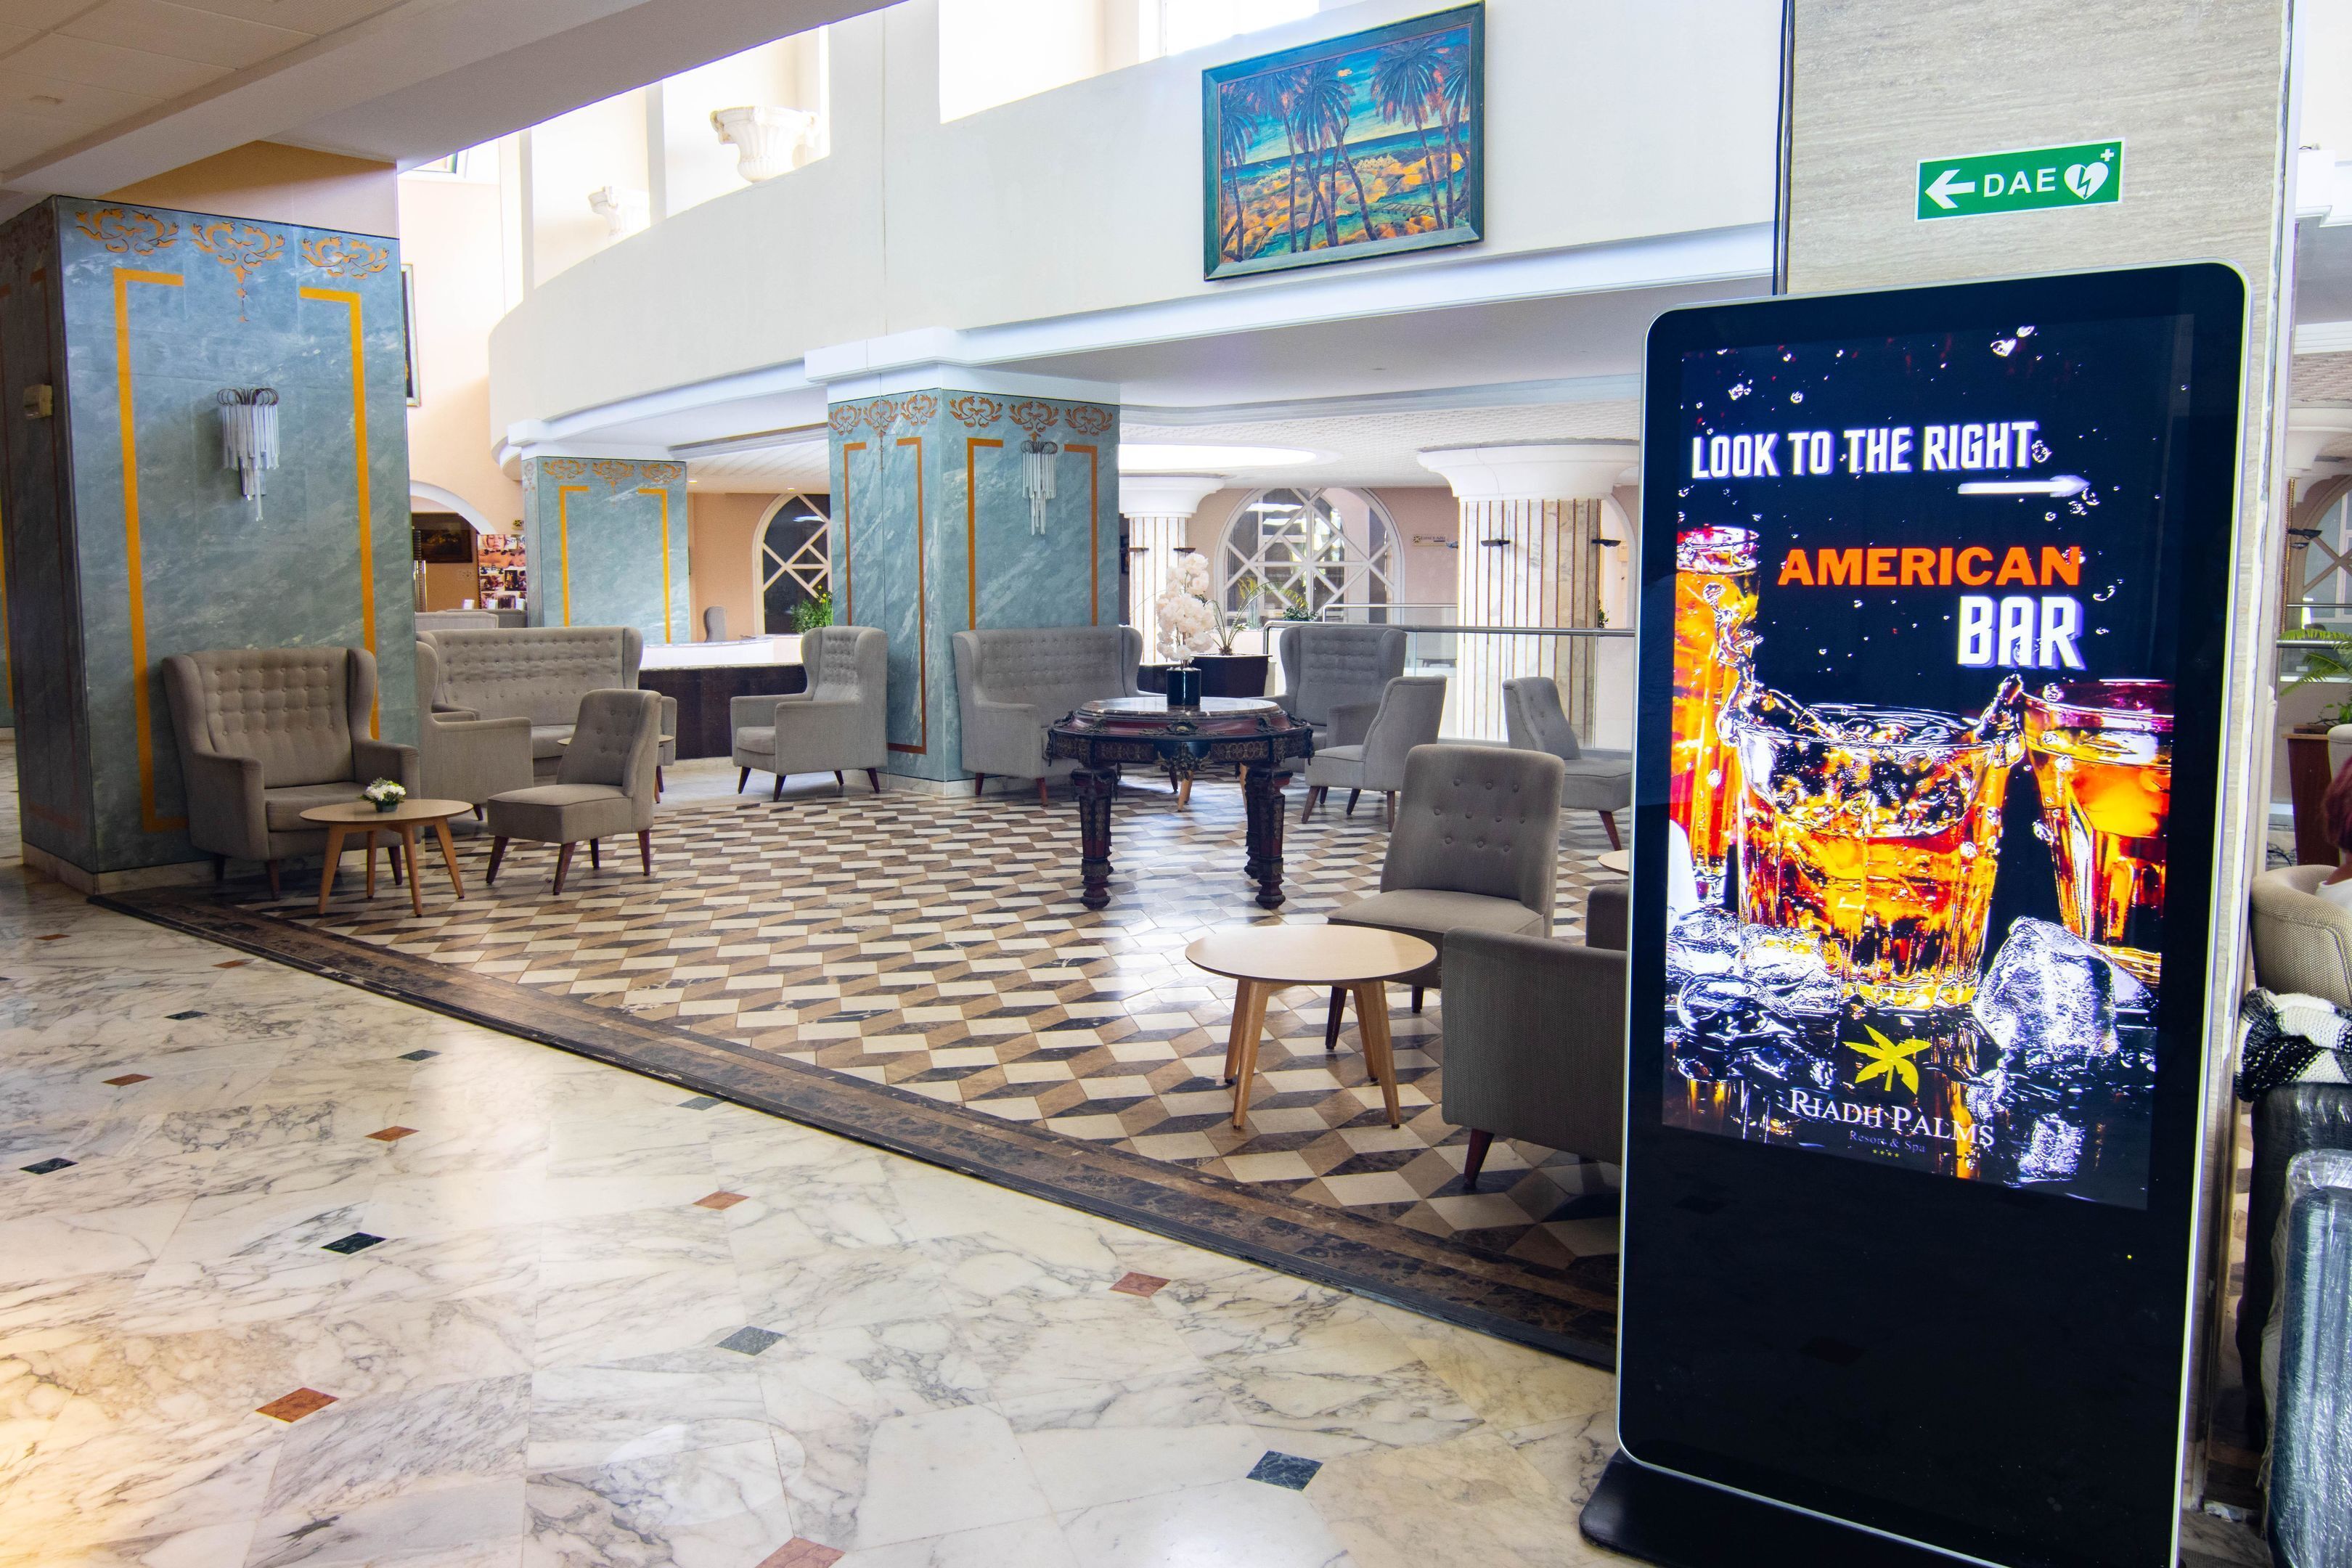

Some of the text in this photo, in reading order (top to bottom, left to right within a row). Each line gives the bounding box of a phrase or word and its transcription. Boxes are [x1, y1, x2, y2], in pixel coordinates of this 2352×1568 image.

[1983, 167, 2057, 197] DAE
[1691, 421, 2039, 479] LOOK TO THE RIGHT
[1778, 547, 2081, 586] AMERICAN
[1957, 595, 2087, 670] BAR
[1789, 1089, 1995, 1147] RIADH PALMS
[1850, 1130, 1926, 1153] Resort & Spa
